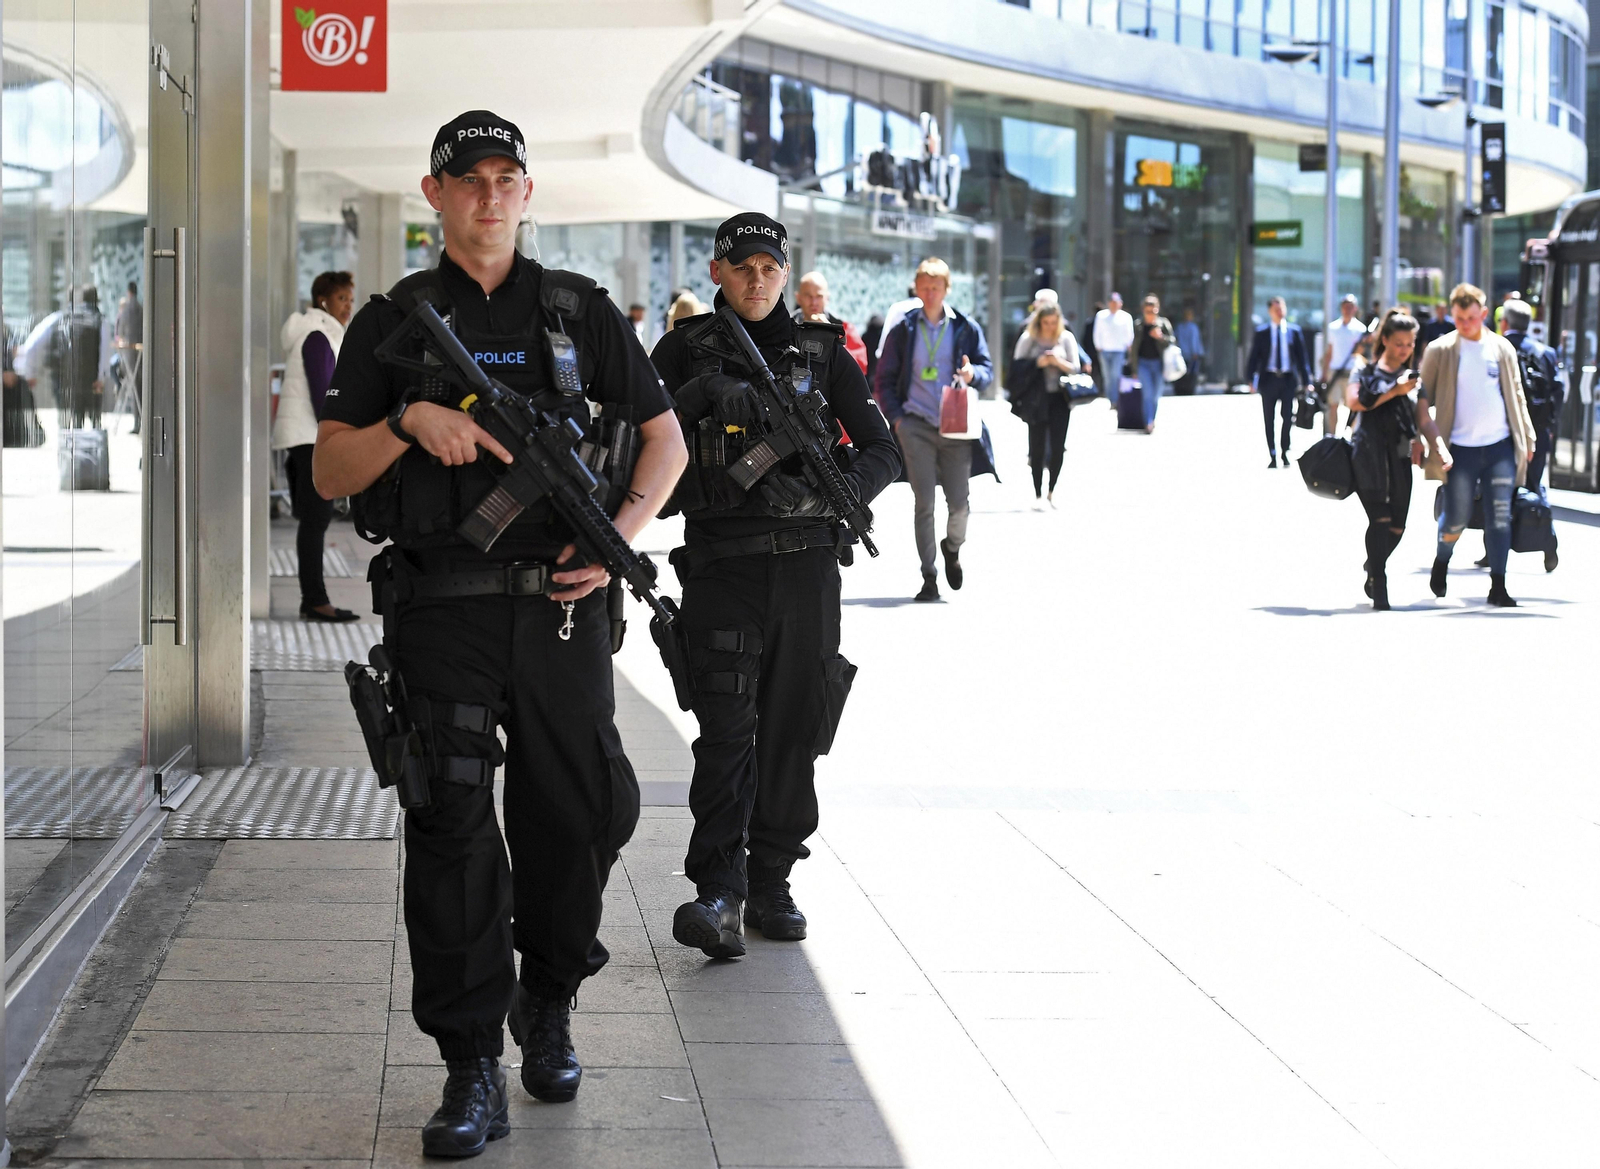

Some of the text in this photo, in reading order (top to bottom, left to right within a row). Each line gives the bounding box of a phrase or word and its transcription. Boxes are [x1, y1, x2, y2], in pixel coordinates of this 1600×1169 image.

[456, 126, 512, 143] POLICE
[736, 225, 778, 240] POLICE
[474, 351, 526, 364] POLICE
